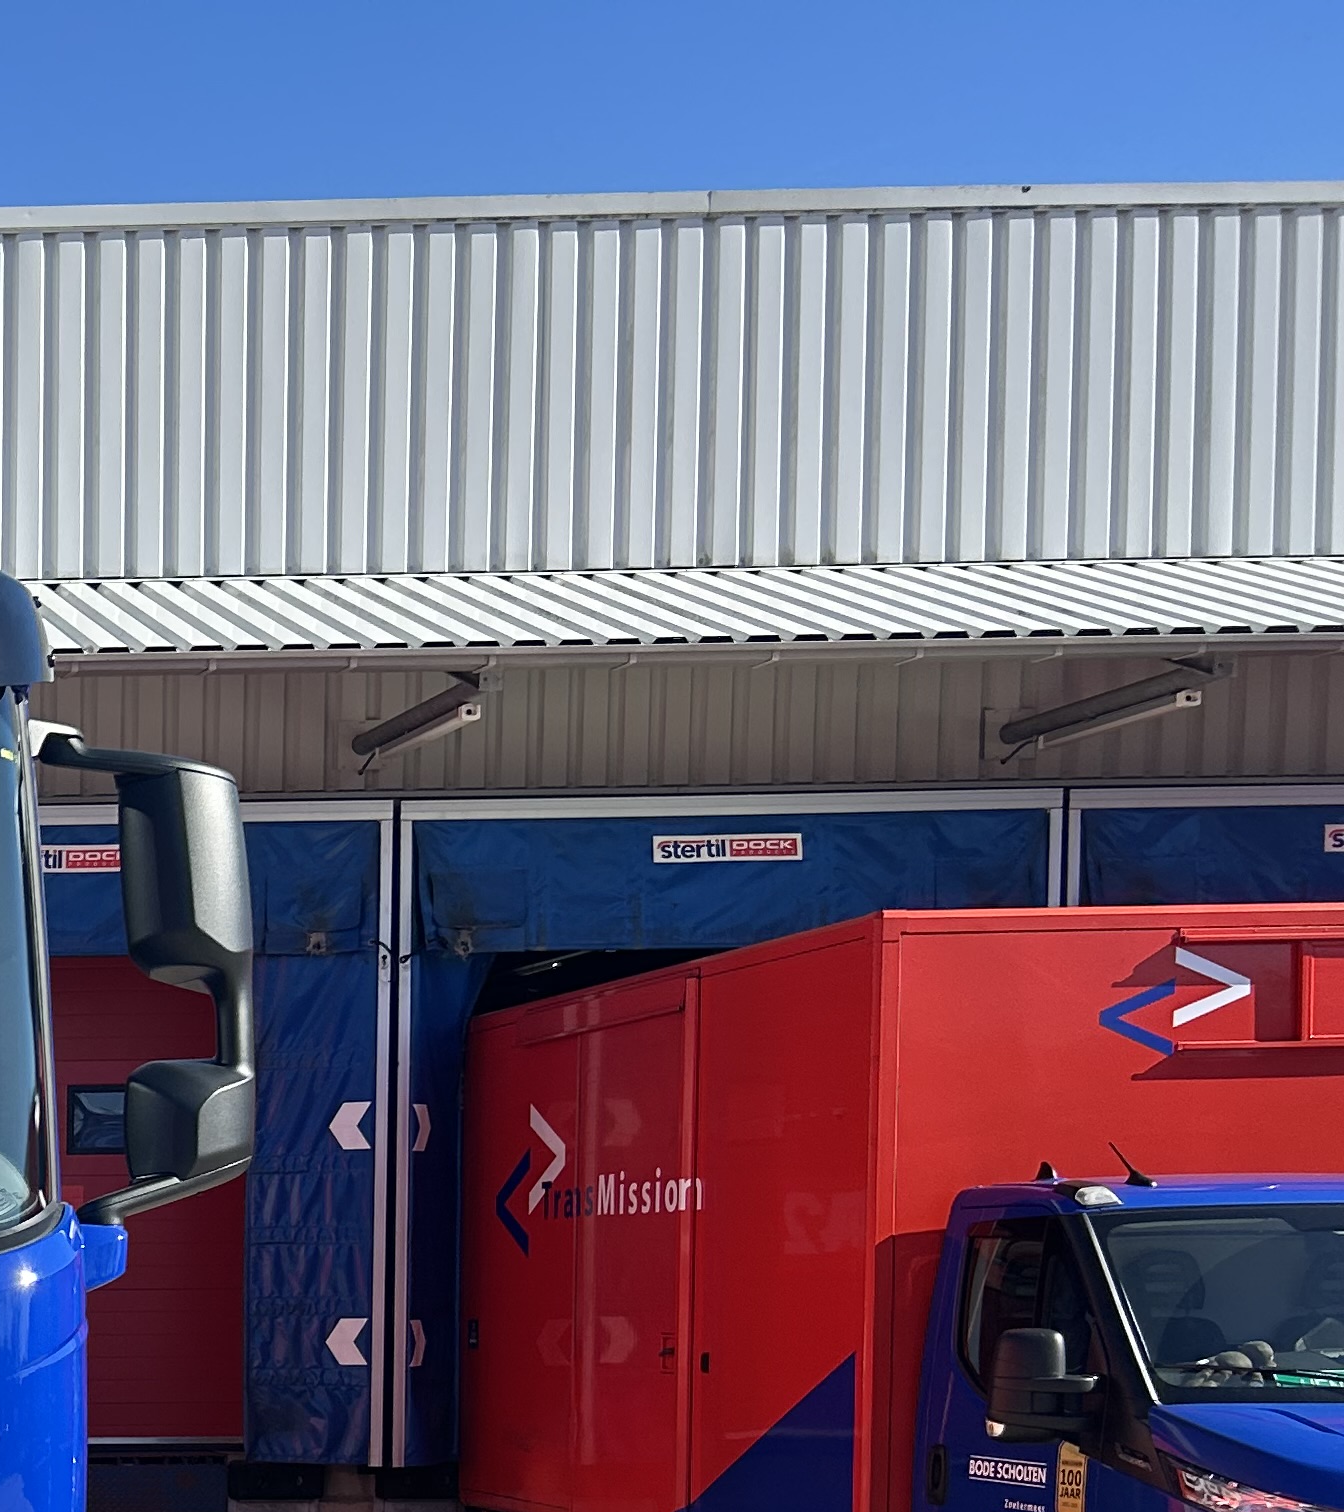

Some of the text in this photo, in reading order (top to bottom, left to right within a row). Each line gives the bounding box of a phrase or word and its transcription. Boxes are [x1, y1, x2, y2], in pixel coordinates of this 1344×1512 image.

[661, 839, 793, 859] stertil DOCK
[968, 1459, 1047, 1484] BODE SCHOLTEN
[1060, 1468, 1082, 1487] 100
[1059, 1487, 1081, 1500] JAAR
